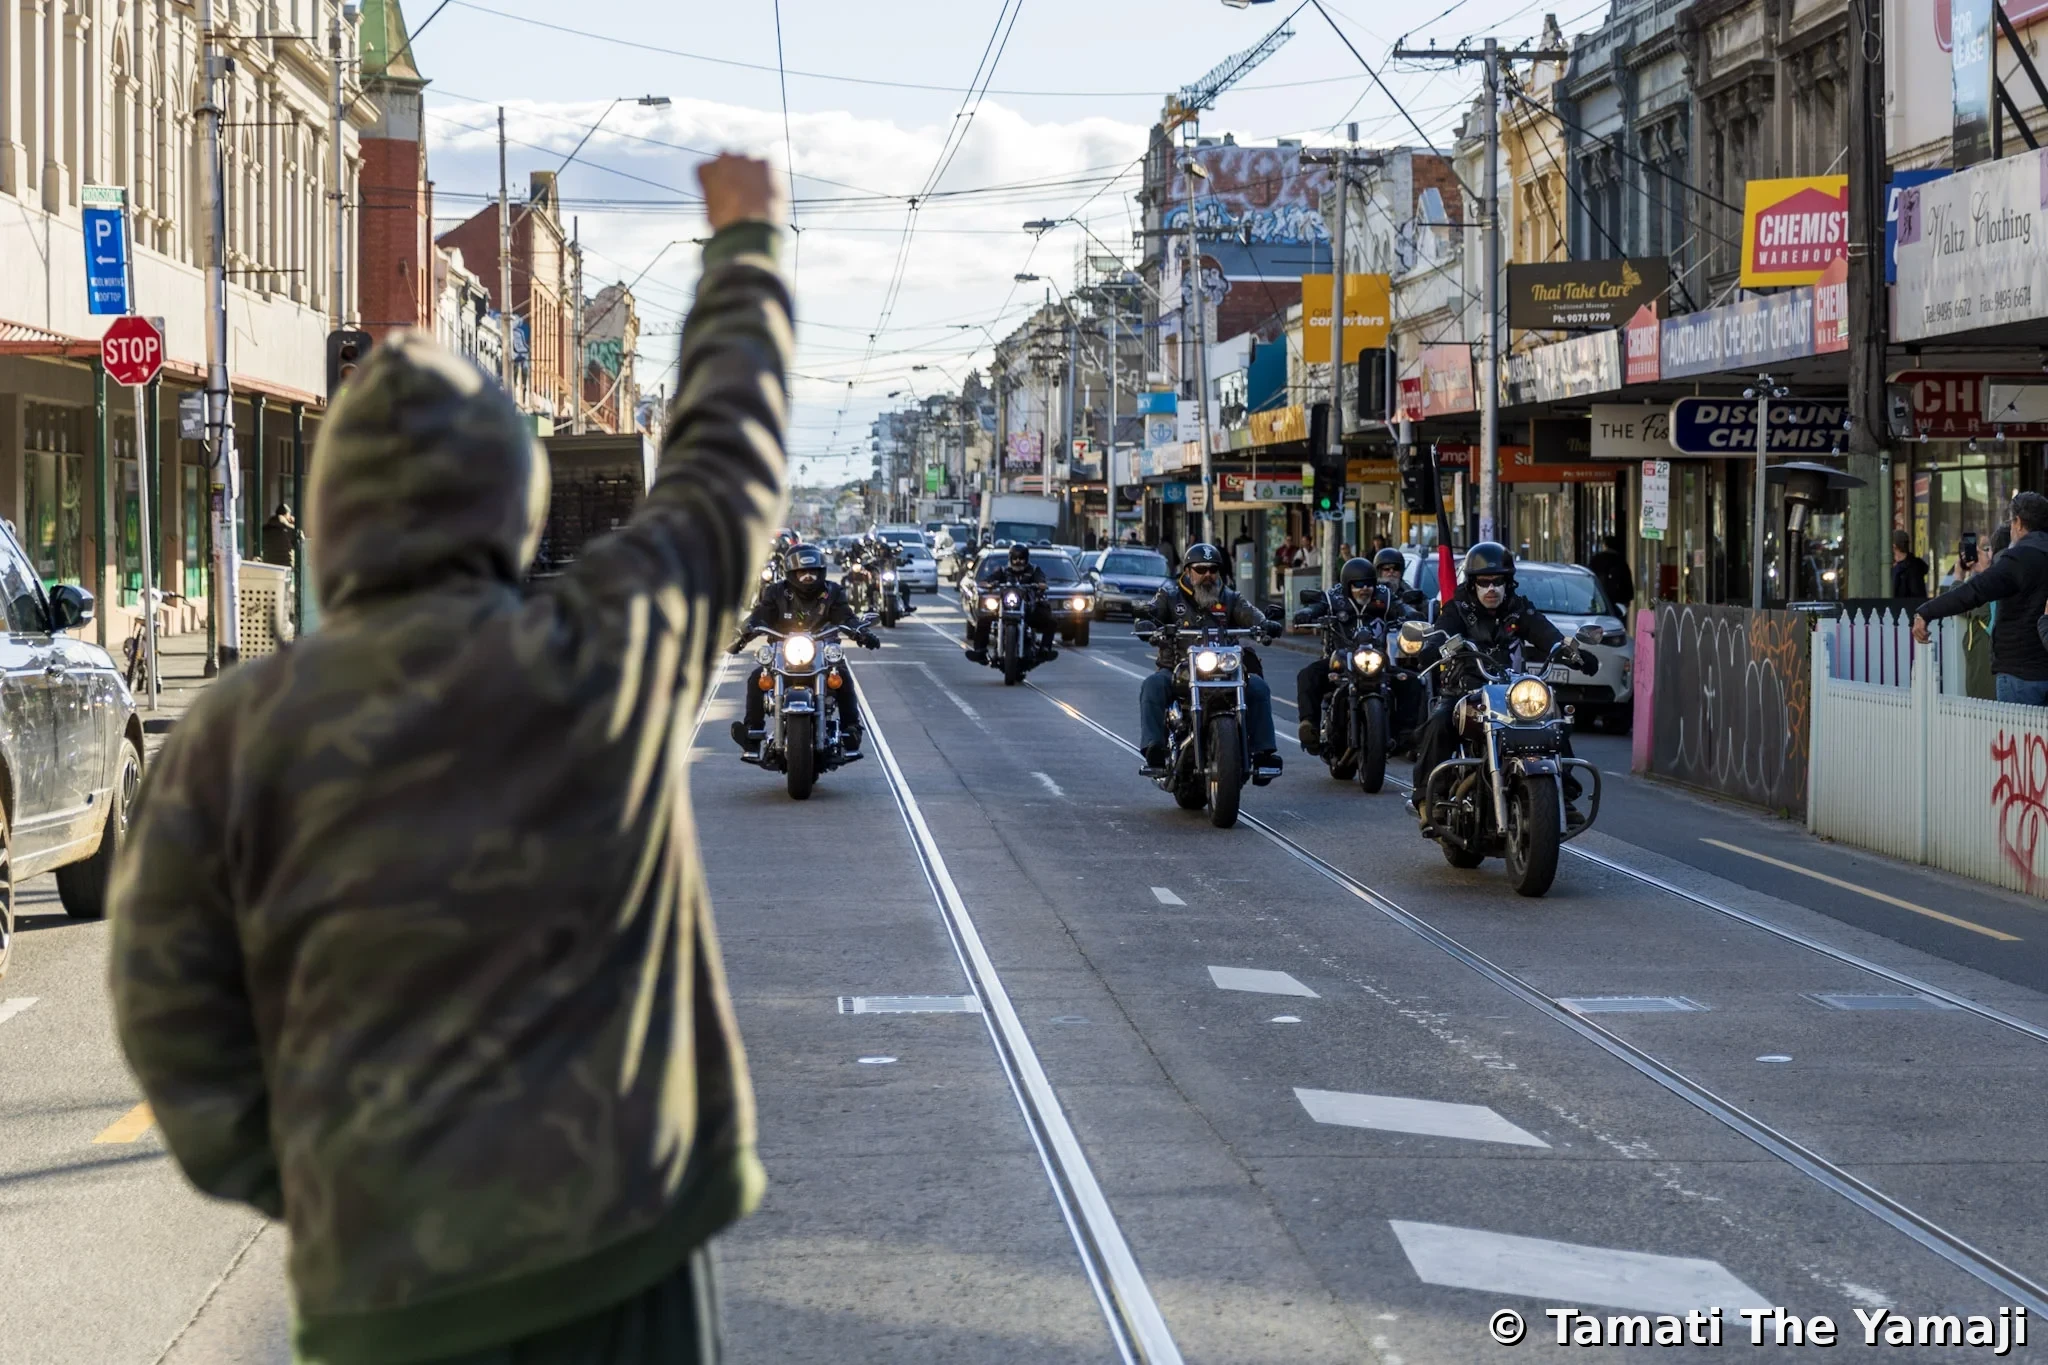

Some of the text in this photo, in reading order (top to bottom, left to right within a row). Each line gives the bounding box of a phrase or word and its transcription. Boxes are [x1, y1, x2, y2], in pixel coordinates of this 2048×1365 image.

[1952, 11, 1973, 36] FOR
[1954, 37, 1985, 70] LEASE
[95, 219, 112, 247] P
[1759, 211, 1848, 247] CHEMIST
[1928, 202, 1965, 258] Waltz
[1972, 191, 2031, 247] Clothing
[1531, 280, 1630, 301] Thai Take Care
[1567, 313, 1588, 322] 9078
[1589, 312, 1611, 321] 9799
[1723, 310, 1768, 357] CHEAPEST
[1770, 300, 1812, 348] CHEMIST
[106, 336, 159, 364] STOP
[1627, 326, 1657, 359] CHEMIST
[1600, 424, 1634, 439] THE
[1657, 463, 1668, 474] 2P
[1643, 506, 1654, 517] 6P
